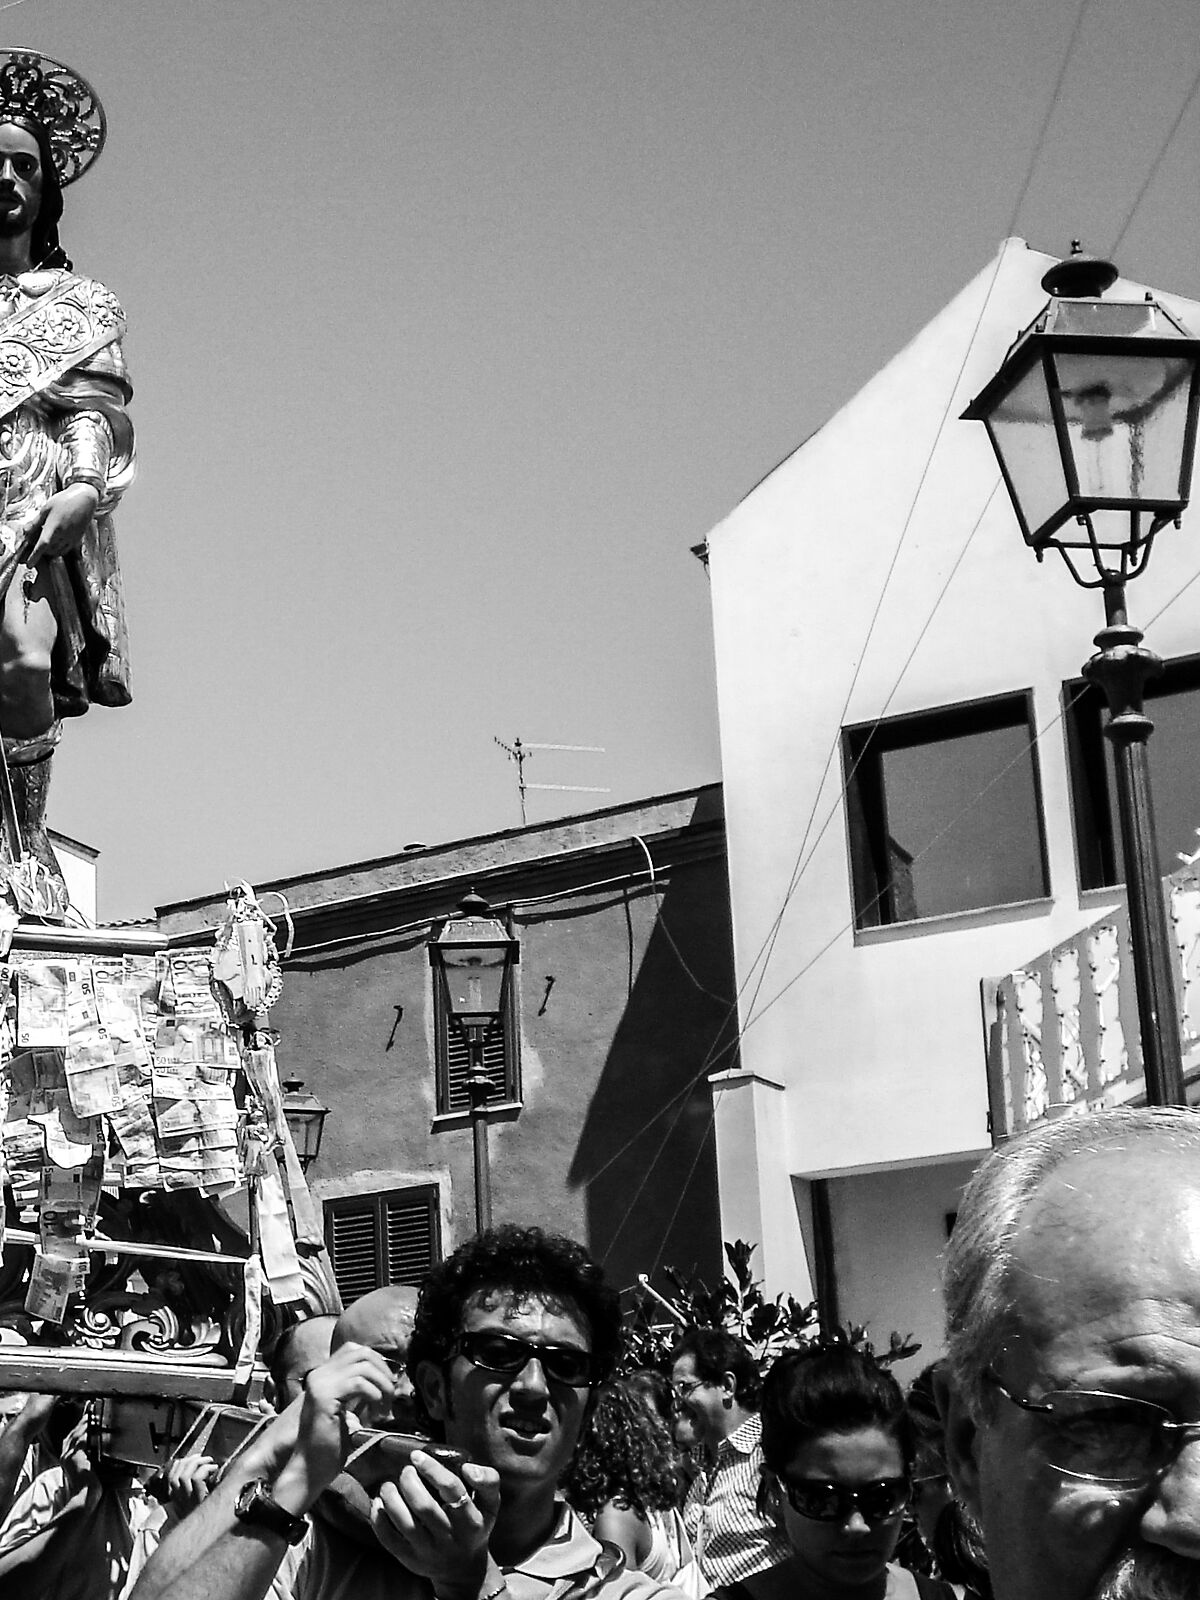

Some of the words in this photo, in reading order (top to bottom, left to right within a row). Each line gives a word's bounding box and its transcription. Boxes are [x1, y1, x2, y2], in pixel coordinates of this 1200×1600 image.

[0, 967, 9, 982] 100
[95, 970, 109, 983] 10
[81, 983, 91, 995] 50
[21, 1032, 30, 1044] 50
[98, 1028, 107, 1040] 50
[156, 1056, 166, 1065] 50
[112, 1096, 120, 1108] 50
[43, 1210, 57, 1228] 10
